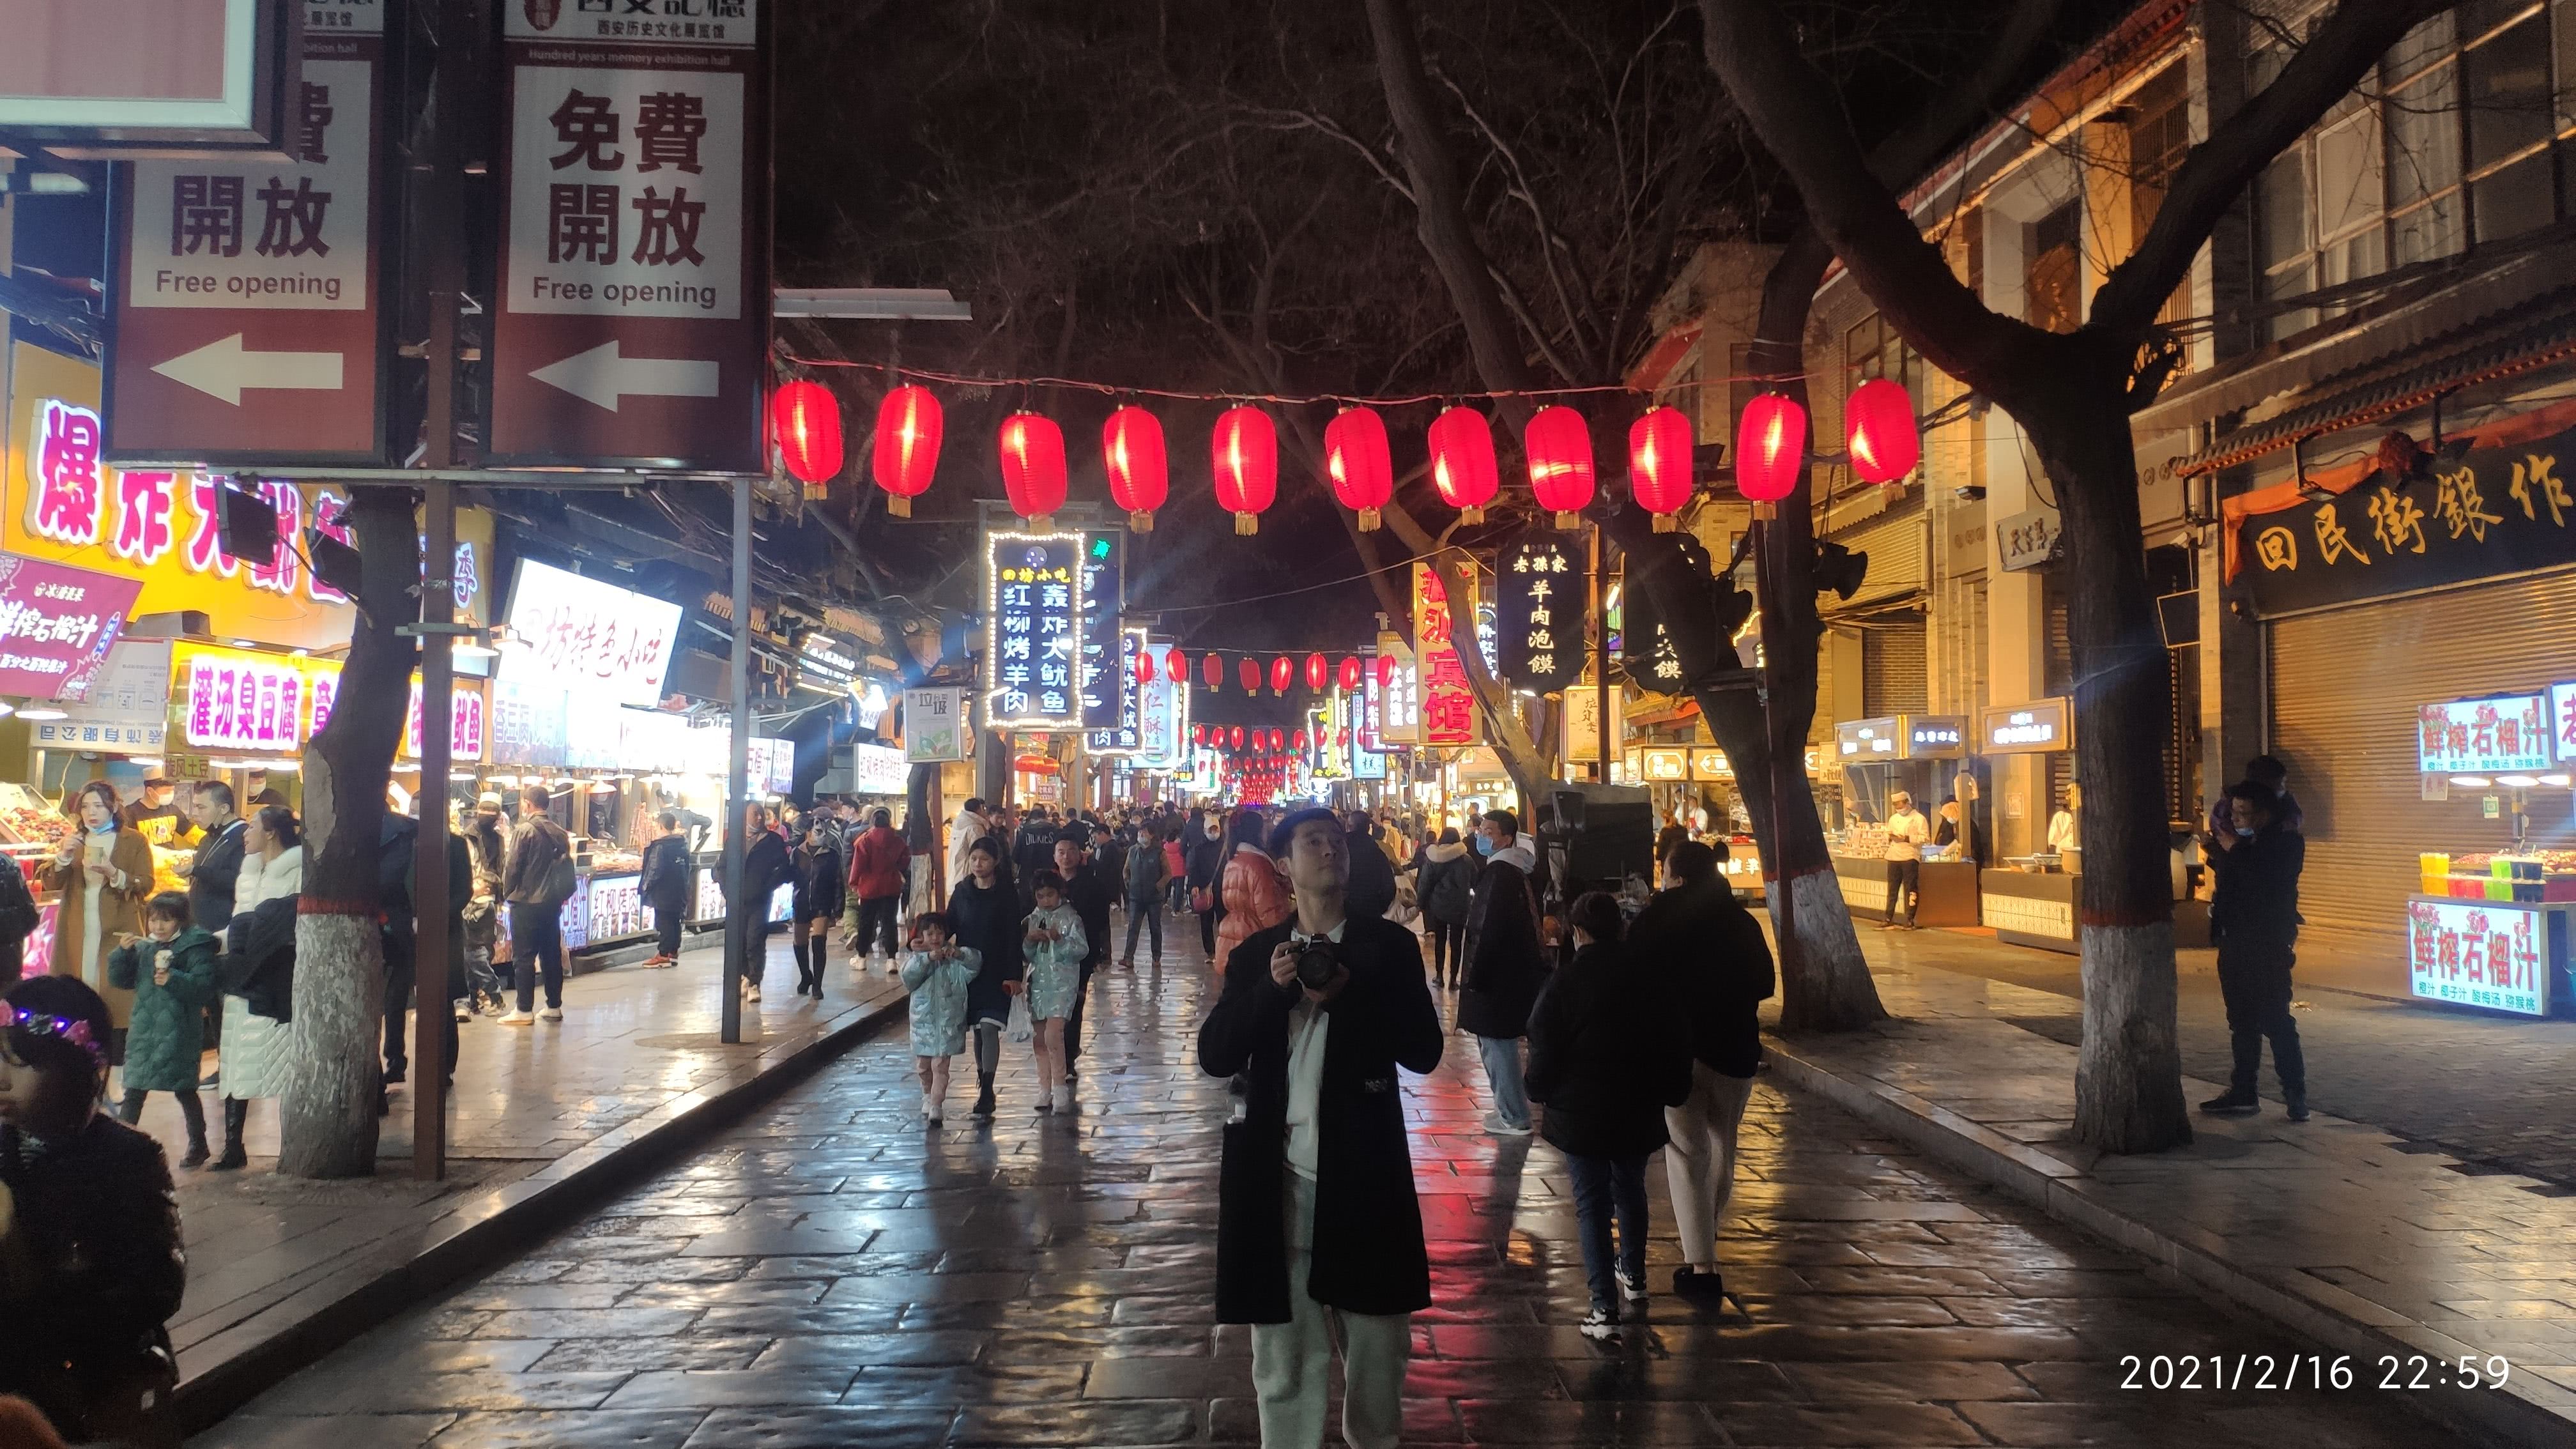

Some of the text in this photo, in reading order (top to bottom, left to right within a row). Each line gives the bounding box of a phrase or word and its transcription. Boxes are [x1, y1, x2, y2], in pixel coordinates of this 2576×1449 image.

[528, 49, 730, 66] Hundred years memory exhibition hall
[549, 88, 707, 175] 免費
[172, 175, 332, 258] 開放
[548, 183, 707, 267] 開放
[156, 270, 341, 301] Free opening
[533, 276, 717, 310] Free opening
[1002, 583, 1032, 714] 红柳烤羊肉
[1039, 583, 1070, 714] 轰炸大鱿鱼
[2423, 698, 2547, 759] 鲜榨石榴汁
[2412, 912, 2539, 993] 鲜榨石榴汁
